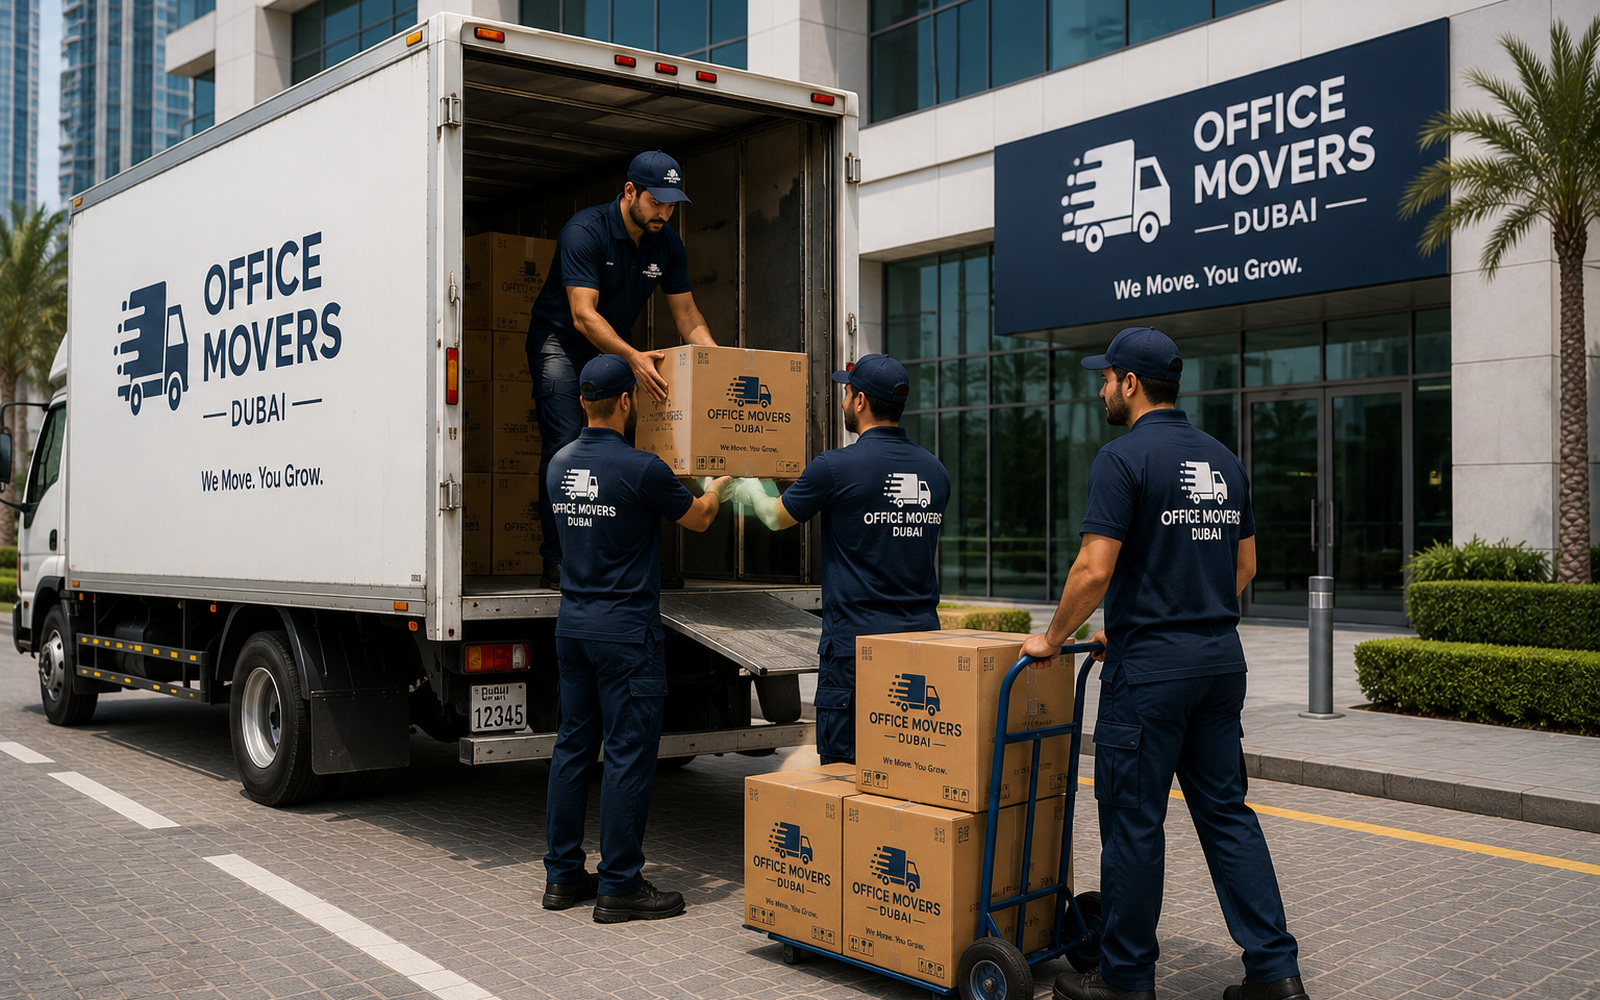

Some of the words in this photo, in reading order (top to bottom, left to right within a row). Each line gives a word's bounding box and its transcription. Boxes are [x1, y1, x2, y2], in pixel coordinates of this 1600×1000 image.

[1194, 75, 1345, 152] OFFICE
[1194, 125, 1376, 204] MOVERS
[1234, 197, 1317, 235] DUBAI
[204, 231, 321, 315] OFFICE
[1113, 279, 1141, 300] We
[1146, 274, 1200, 296] Move.
[1203, 265, 1238, 287] You
[1244, 257, 1302, 280] Grow.
[203, 302, 342, 381] MOVERS
[231, 392, 285, 427] DUBAI
[707, 408, 744, 421] OFFICE
[748, 410, 791, 423] MOVERS
[734, 423, 764, 434] DUBAI
[201, 470, 218, 492] We
[222, 469, 255, 491] Move.
[258, 466, 280, 489] You
[284, 464, 323, 487] Grow.
[552, 503, 576, 514] OFFICE
[578, 504, 617, 517] MOVERS
[863, 512, 903, 524] OFFICE
[906, 512, 942, 524] MOVERS
[1161, 509, 1200, 526] OFFICE
[1203, 509, 1241, 525] MOVERS
[567, 516, 593, 527] DUBAI
[892, 526, 923, 537] DUBAI
[1192, 527, 1222, 540] DUBAI
[475, 704, 523, 729] 12345
[869, 711, 909, 729] OFFICE
[912, 717, 962, 737] MOVERS
[898, 732, 931, 748] DUBAI
[882, 756, 893, 765] We
[914, 761, 926, 771] You
[927, 764, 948, 775] Grow.
[753, 855, 786, 874] OFFICE
[789, 864, 831, 887] MOVERS
[777, 877, 805, 894] DUBAI
[852, 881, 890, 903] OFFICE
[892, 892, 941, 916] MOVERS
[879, 905, 911, 924] DUBAI
[865, 927, 875, 936] We
